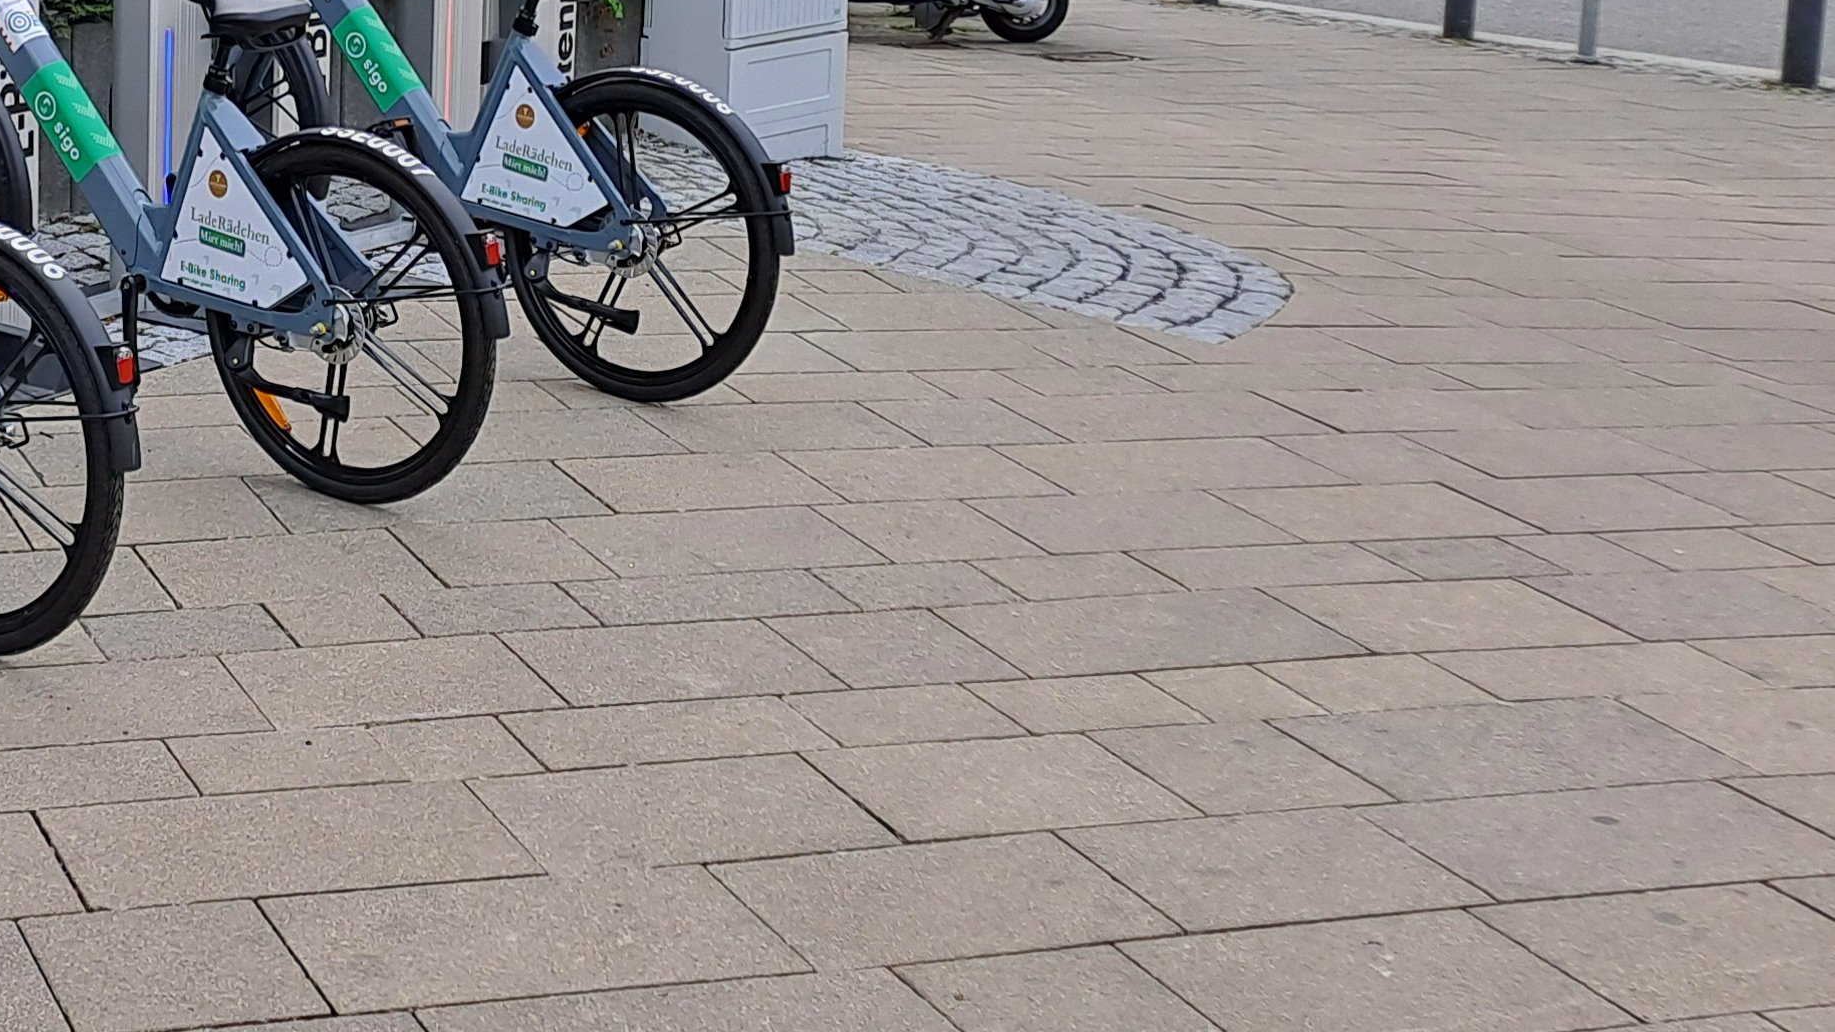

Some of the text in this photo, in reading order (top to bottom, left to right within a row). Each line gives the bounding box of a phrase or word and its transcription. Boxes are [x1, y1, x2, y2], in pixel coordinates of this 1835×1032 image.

[363, 59, 388, 94] sigo
[53, 121, 80, 160] sigo
[495, 135, 573, 172] LadeRädchen
[504, 157, 522, 172] Miet
[481, 183, 508, 199] E-Bike
[511, 190, 546, 212] Sharing
[191, 207, 270, 245] LadeRädchen
[200, 229, 244, 254] Miet mich!
[180, 260, 207, 278] E-Bike
[209, 269, 246, 292] Sharing
